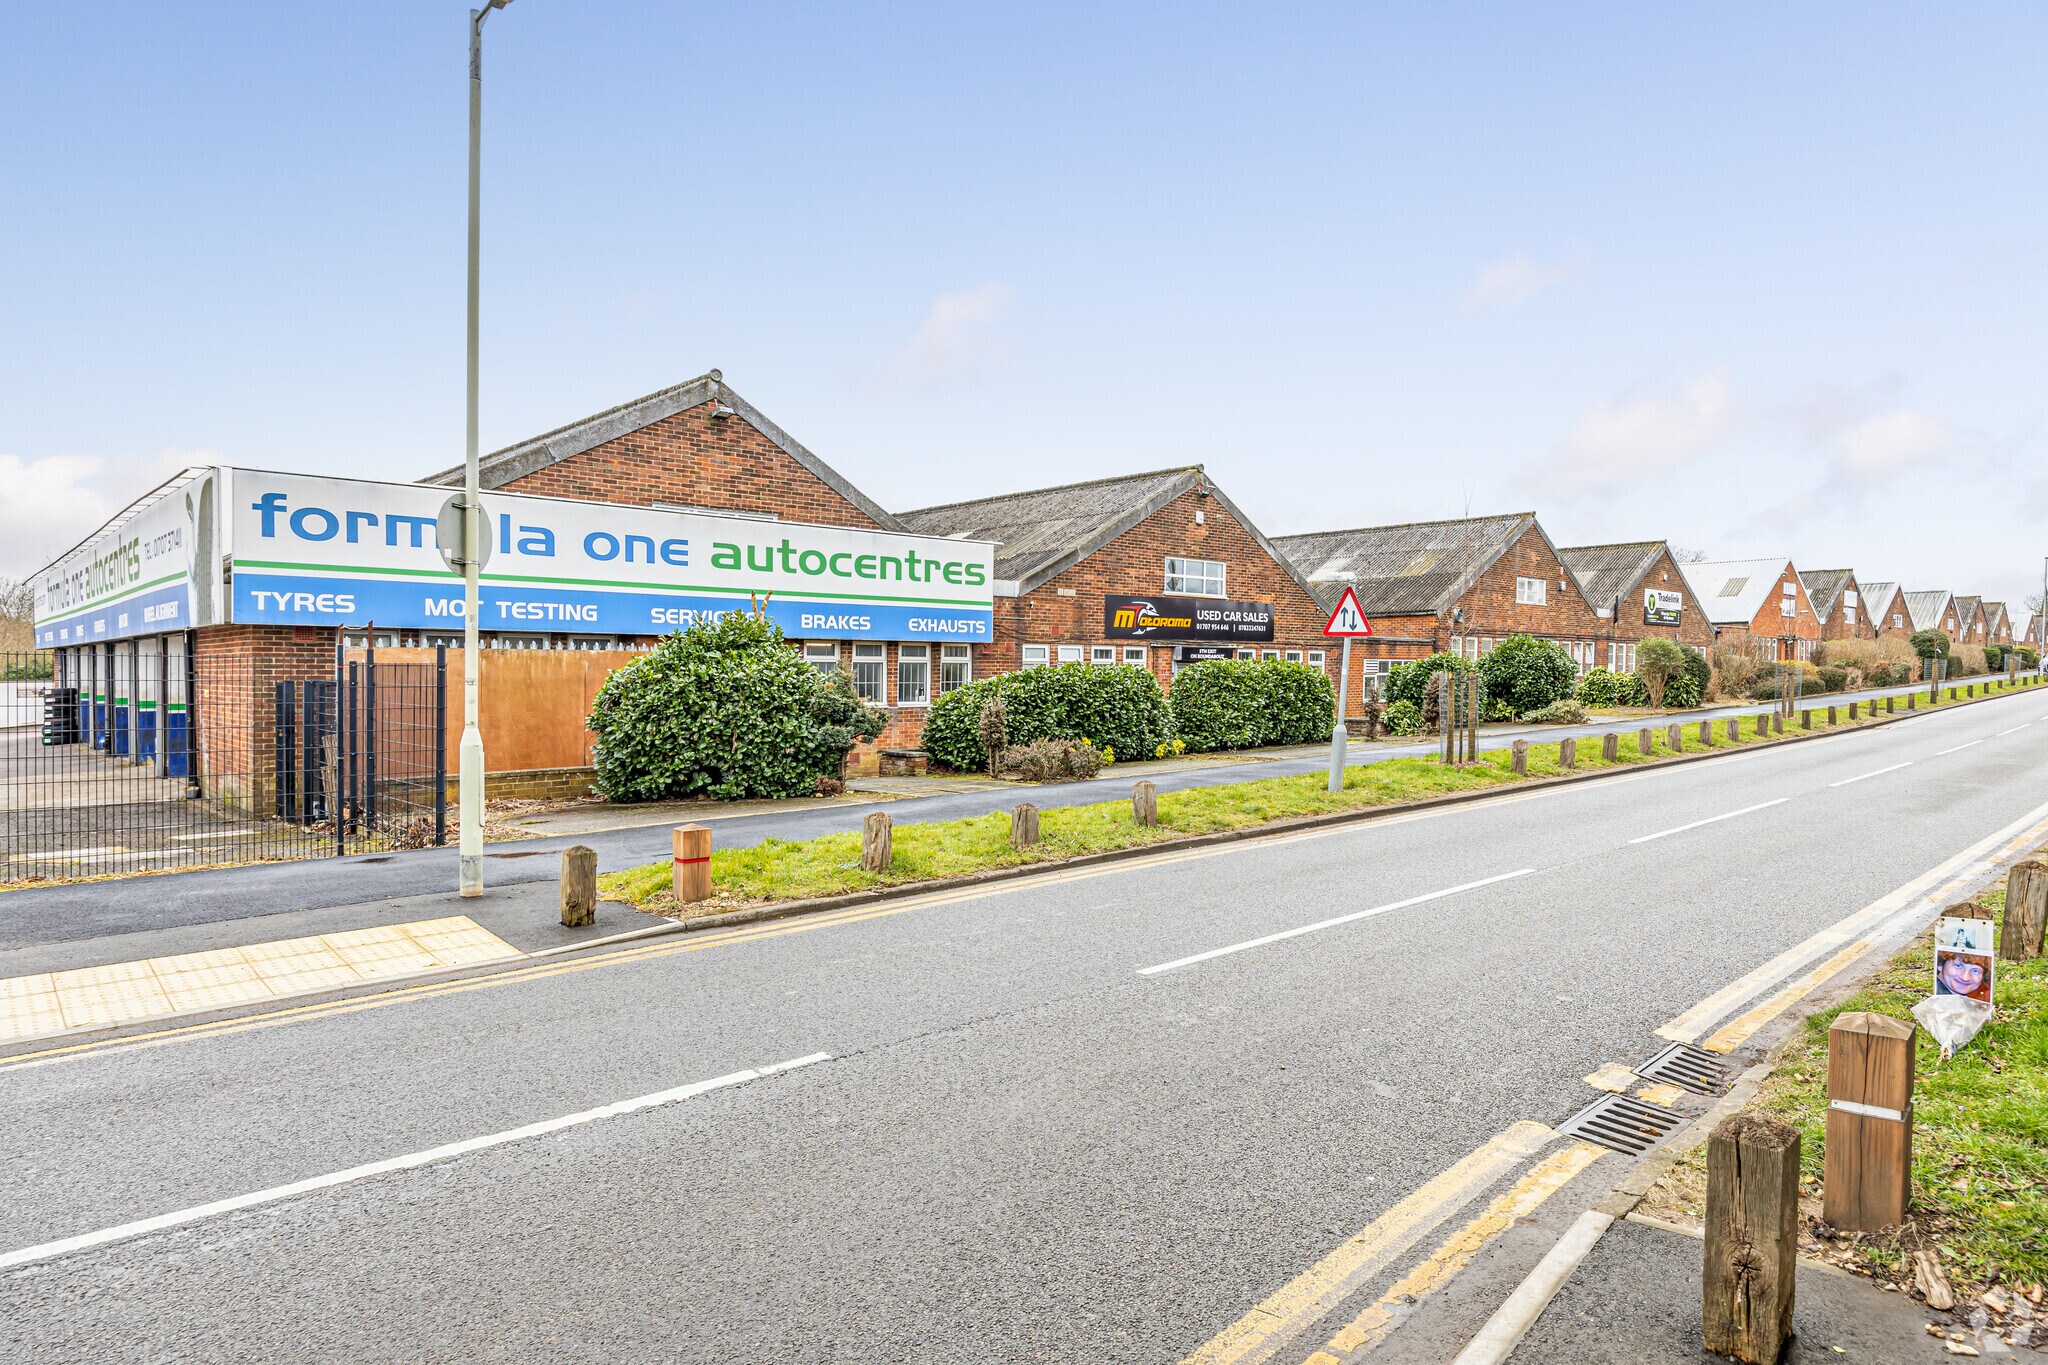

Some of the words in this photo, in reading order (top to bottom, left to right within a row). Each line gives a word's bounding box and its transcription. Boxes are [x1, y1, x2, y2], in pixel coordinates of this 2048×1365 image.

[252, 492, 556, 557] formla
[583, 531, 689, 567] one
[710, 539, 986, 586] autocentres
[72, 569, 84, 605] one
[85, 534, 140, 600] autocentres
[251, 591, 356, 613] TYRES
[1658, 592, 1680, 604] Tradelink
[495, 601, 598, 622] TESTING
[1196, 609, 1222, 621] USED
[1222, 610, 1242, 622] CAR
[1242, 611, 1269, 623] SALES
[801, 613, 871, 631] BRAKES
[908, 618, 986, 634] EXHAUSTS
